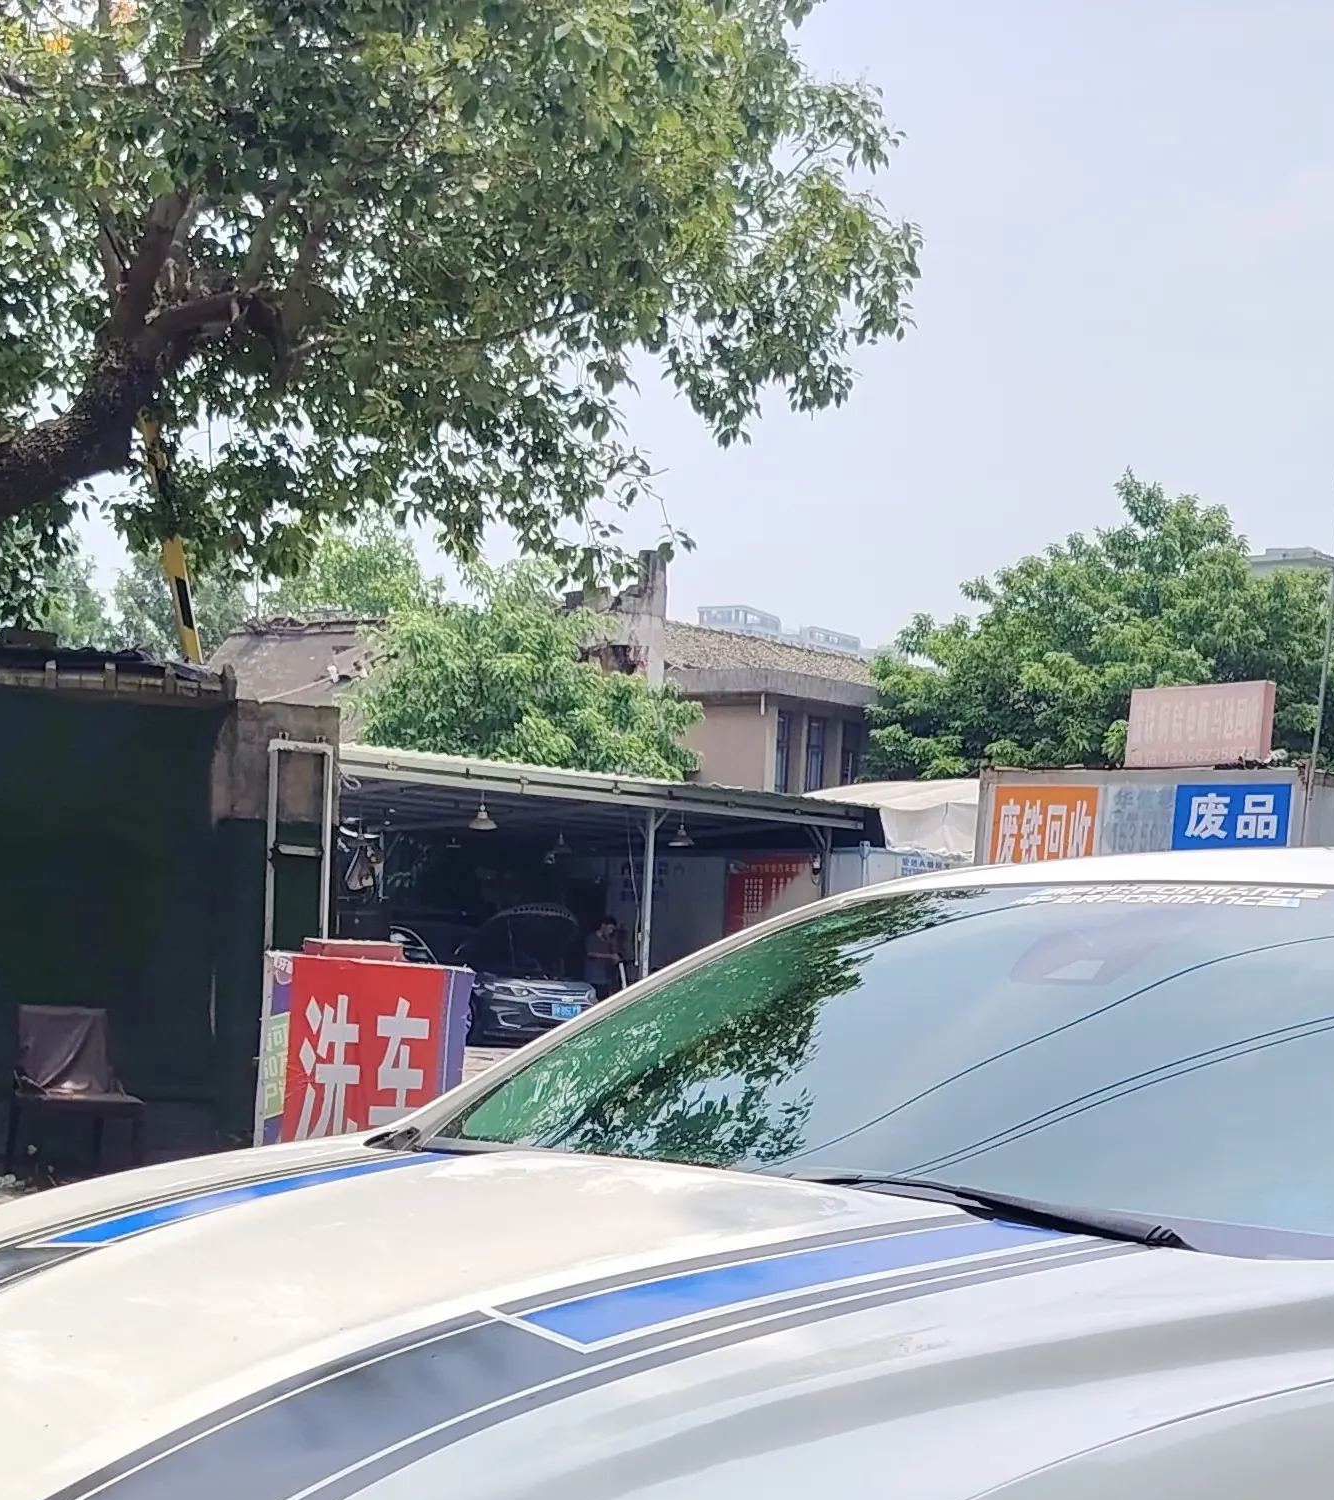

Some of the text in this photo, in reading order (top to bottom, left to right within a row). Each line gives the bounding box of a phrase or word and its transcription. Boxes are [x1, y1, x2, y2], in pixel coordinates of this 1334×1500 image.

[995, 798, 1091, 864] 废铁回收
[1185, 793, 1278, 840] 废品
[295, 994, 430, 1140] 洗车
